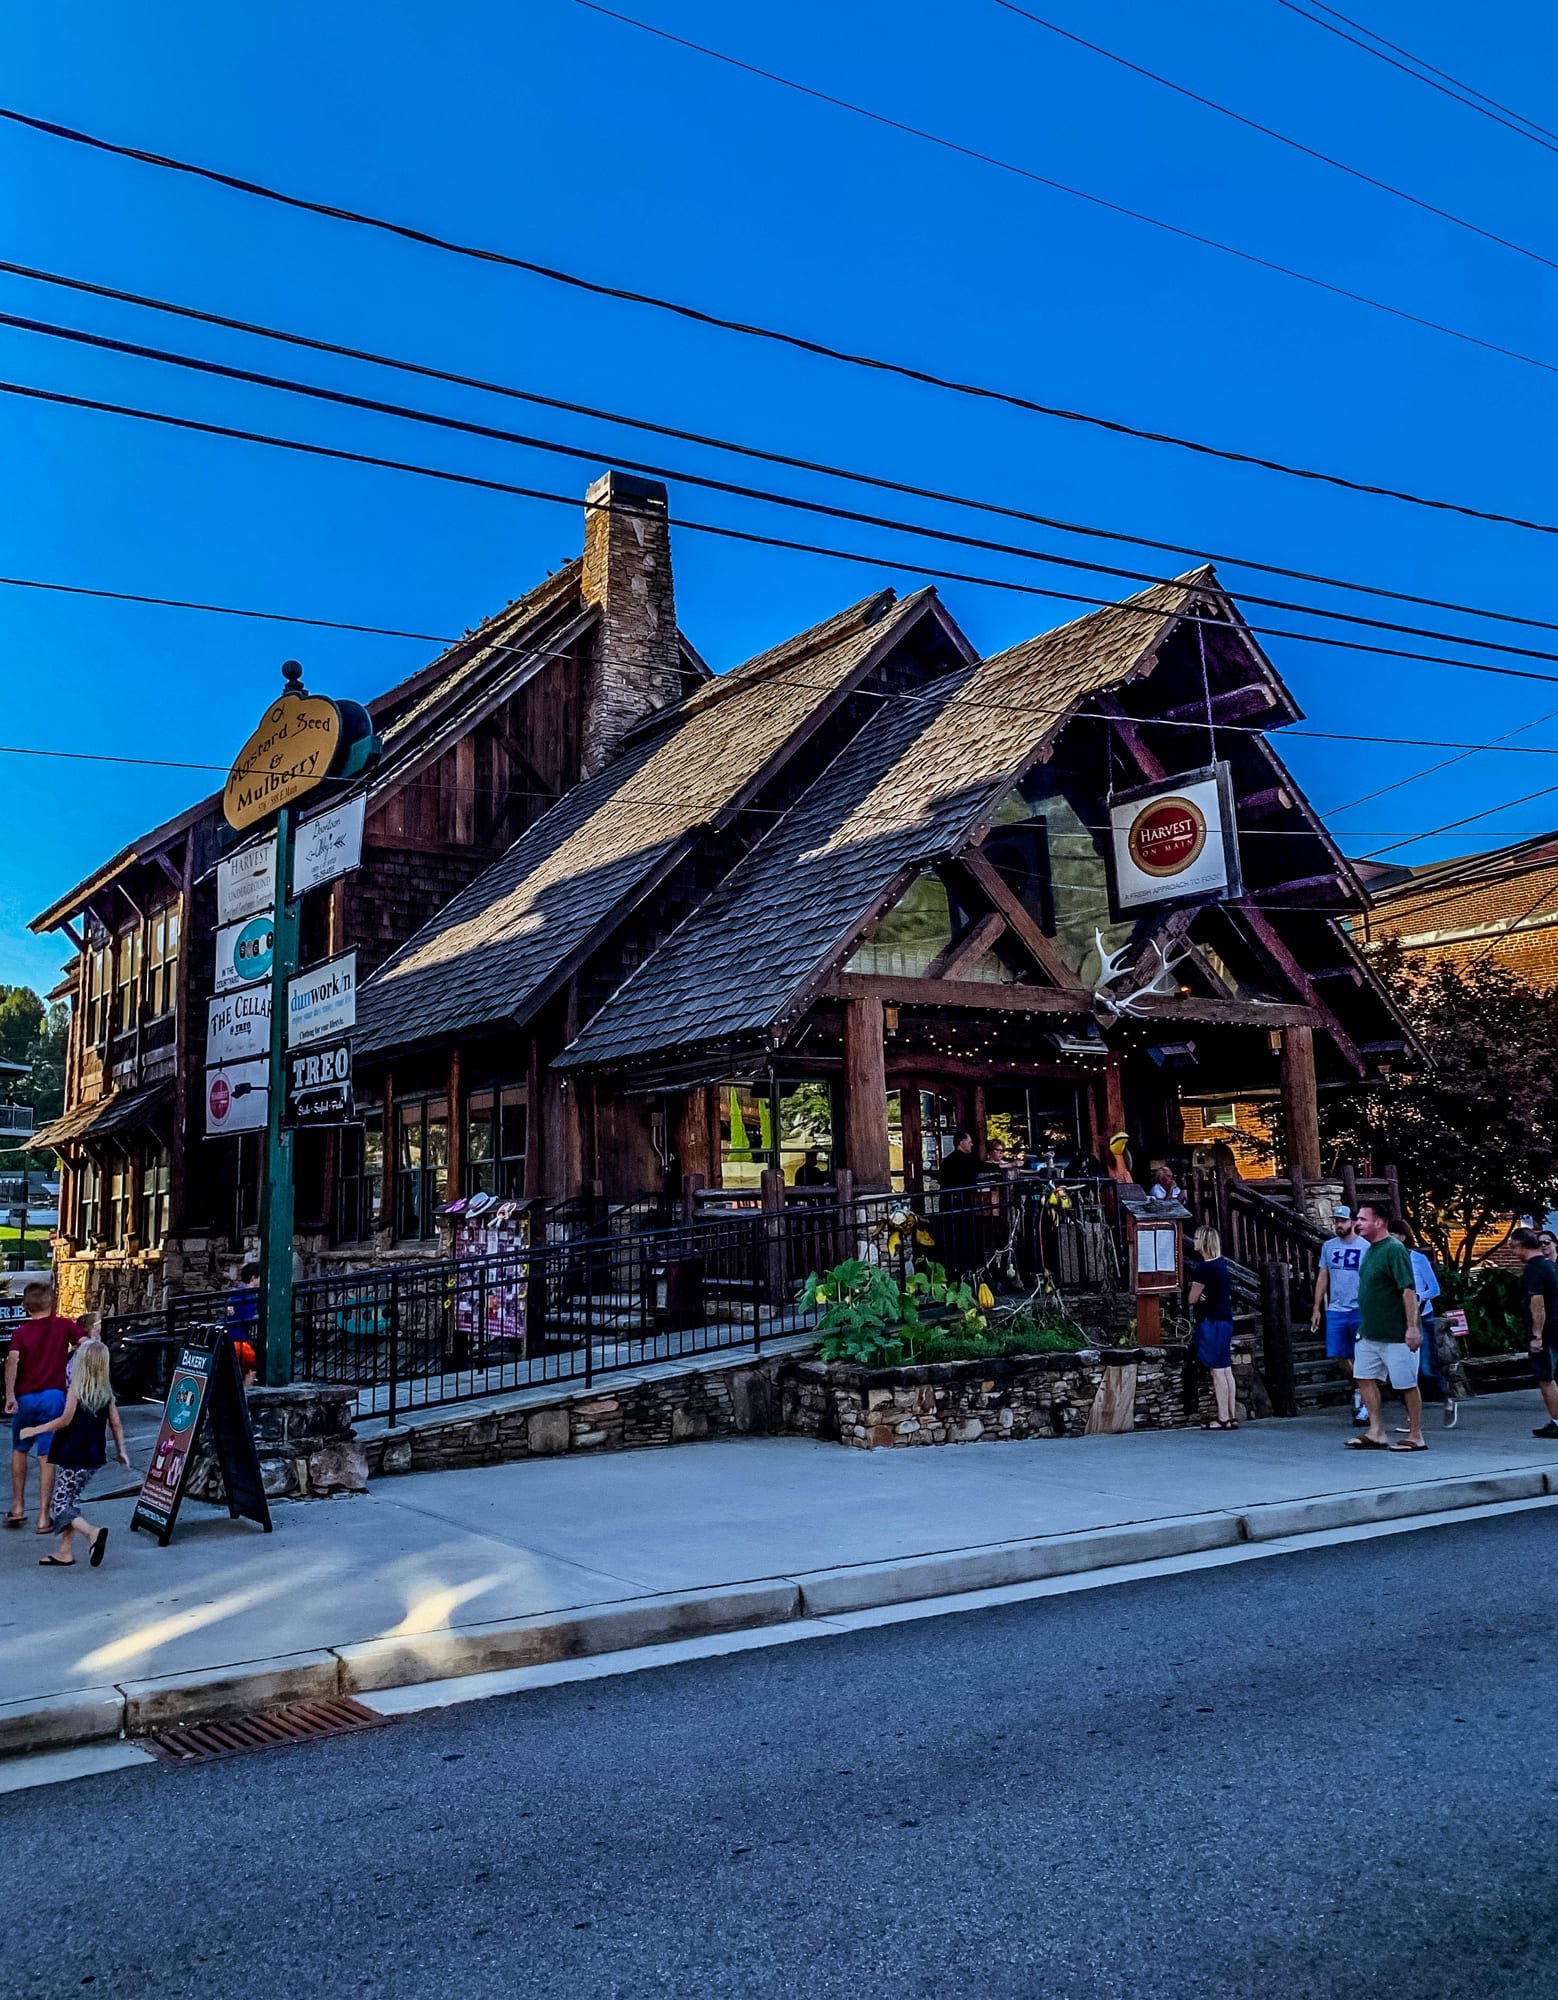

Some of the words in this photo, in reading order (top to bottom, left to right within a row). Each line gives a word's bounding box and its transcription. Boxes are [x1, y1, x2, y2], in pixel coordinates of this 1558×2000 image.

[230, 724, 288, 794] Mustard
[291, 713, 331, 737] Seed
[269, 753, 284, 769] &
[237, 750, 320, 812] Mulberry
[1141, 819, 1192, 843] HARVEST
[1142, 848, 1157, 857] ON
[1164, 839, 1193, 851] MAIN
[231, 847, 270, 876] HARVEST
[228, 876, 271, 901] UNDERGROUND
[1129, 890, 1152, 899] FRESH
[1152, 882, 1189, 895] APPROACH
[1190, 878, 1200, 886] TO
[210, 1006, 232, 1037] THE
[235, 1021, 251, 1033] TREO
[293, 1048, 348, 1088] TREO
[181, 1350, 207, 1369] BAKERY
